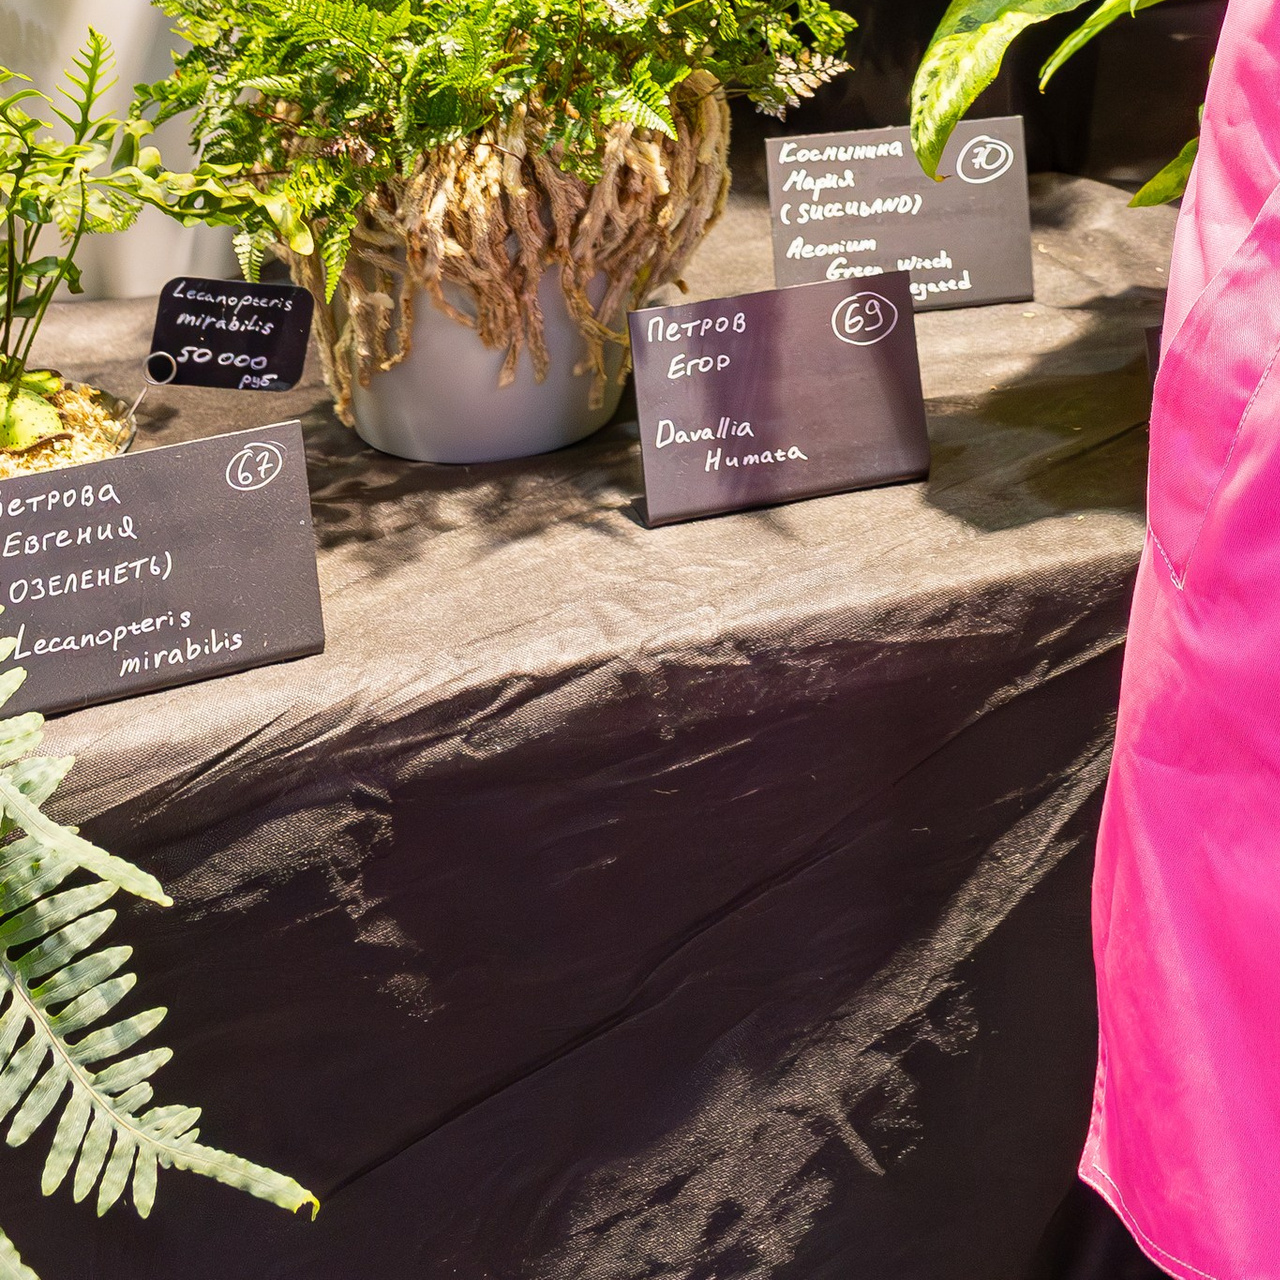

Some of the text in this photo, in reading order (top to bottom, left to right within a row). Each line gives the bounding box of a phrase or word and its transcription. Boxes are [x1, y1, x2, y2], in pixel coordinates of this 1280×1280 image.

[971, 143, 1007, 170] 70
[782, 168, 856, 202] Мария
[786, 236, 877, 260] Aeonium
[826, 256, 884, 281] Green
[172, 280, 293, 314] Lecanopteris
[909, 269, 972, 301] egated
[176, 312, 274, 335] mirabilis
[647, 312, 746, 343] Петров
[844, 299, 884, 334] 69
[177, 346, 268, 370] 50 000
[667, 354, 731, 380] Егор
[655, 416, 755, 449] Davallia
[237, 450, 274, 485] 67
[704, 445, 808, 472] Humata
[0, 483, 121, 518] етрова
[13, 610, 192, 660] Lecanopteris
[119, 629, 243, 678] mirabilis
